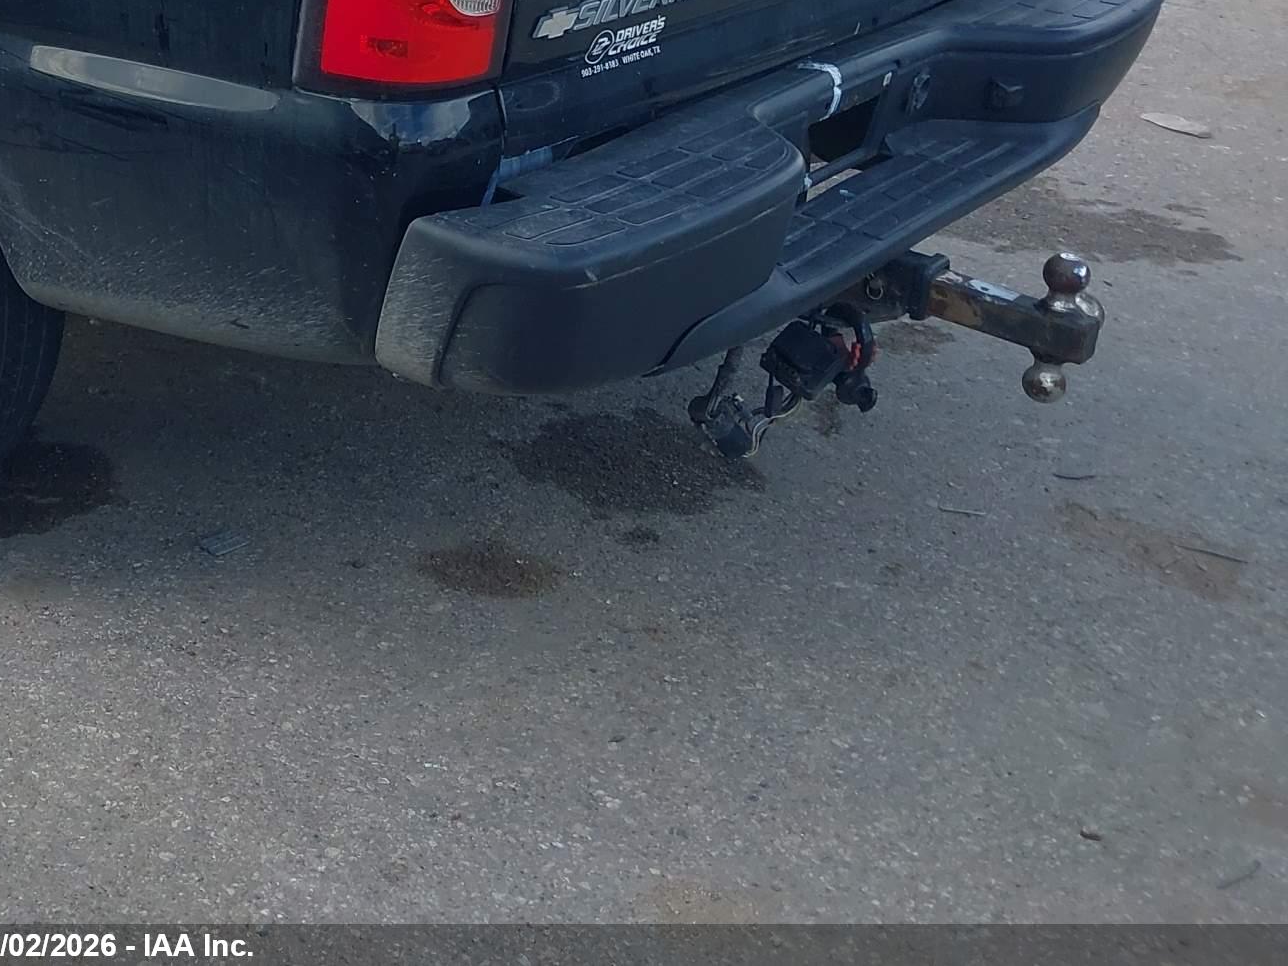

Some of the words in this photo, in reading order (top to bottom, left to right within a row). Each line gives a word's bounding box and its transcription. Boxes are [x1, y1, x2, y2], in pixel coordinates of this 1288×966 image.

[615, 15, 667, 42] DRIVER'S
[607, 31, 661, 55] CHOICE
[622, 51, 641, 65] WHITE
